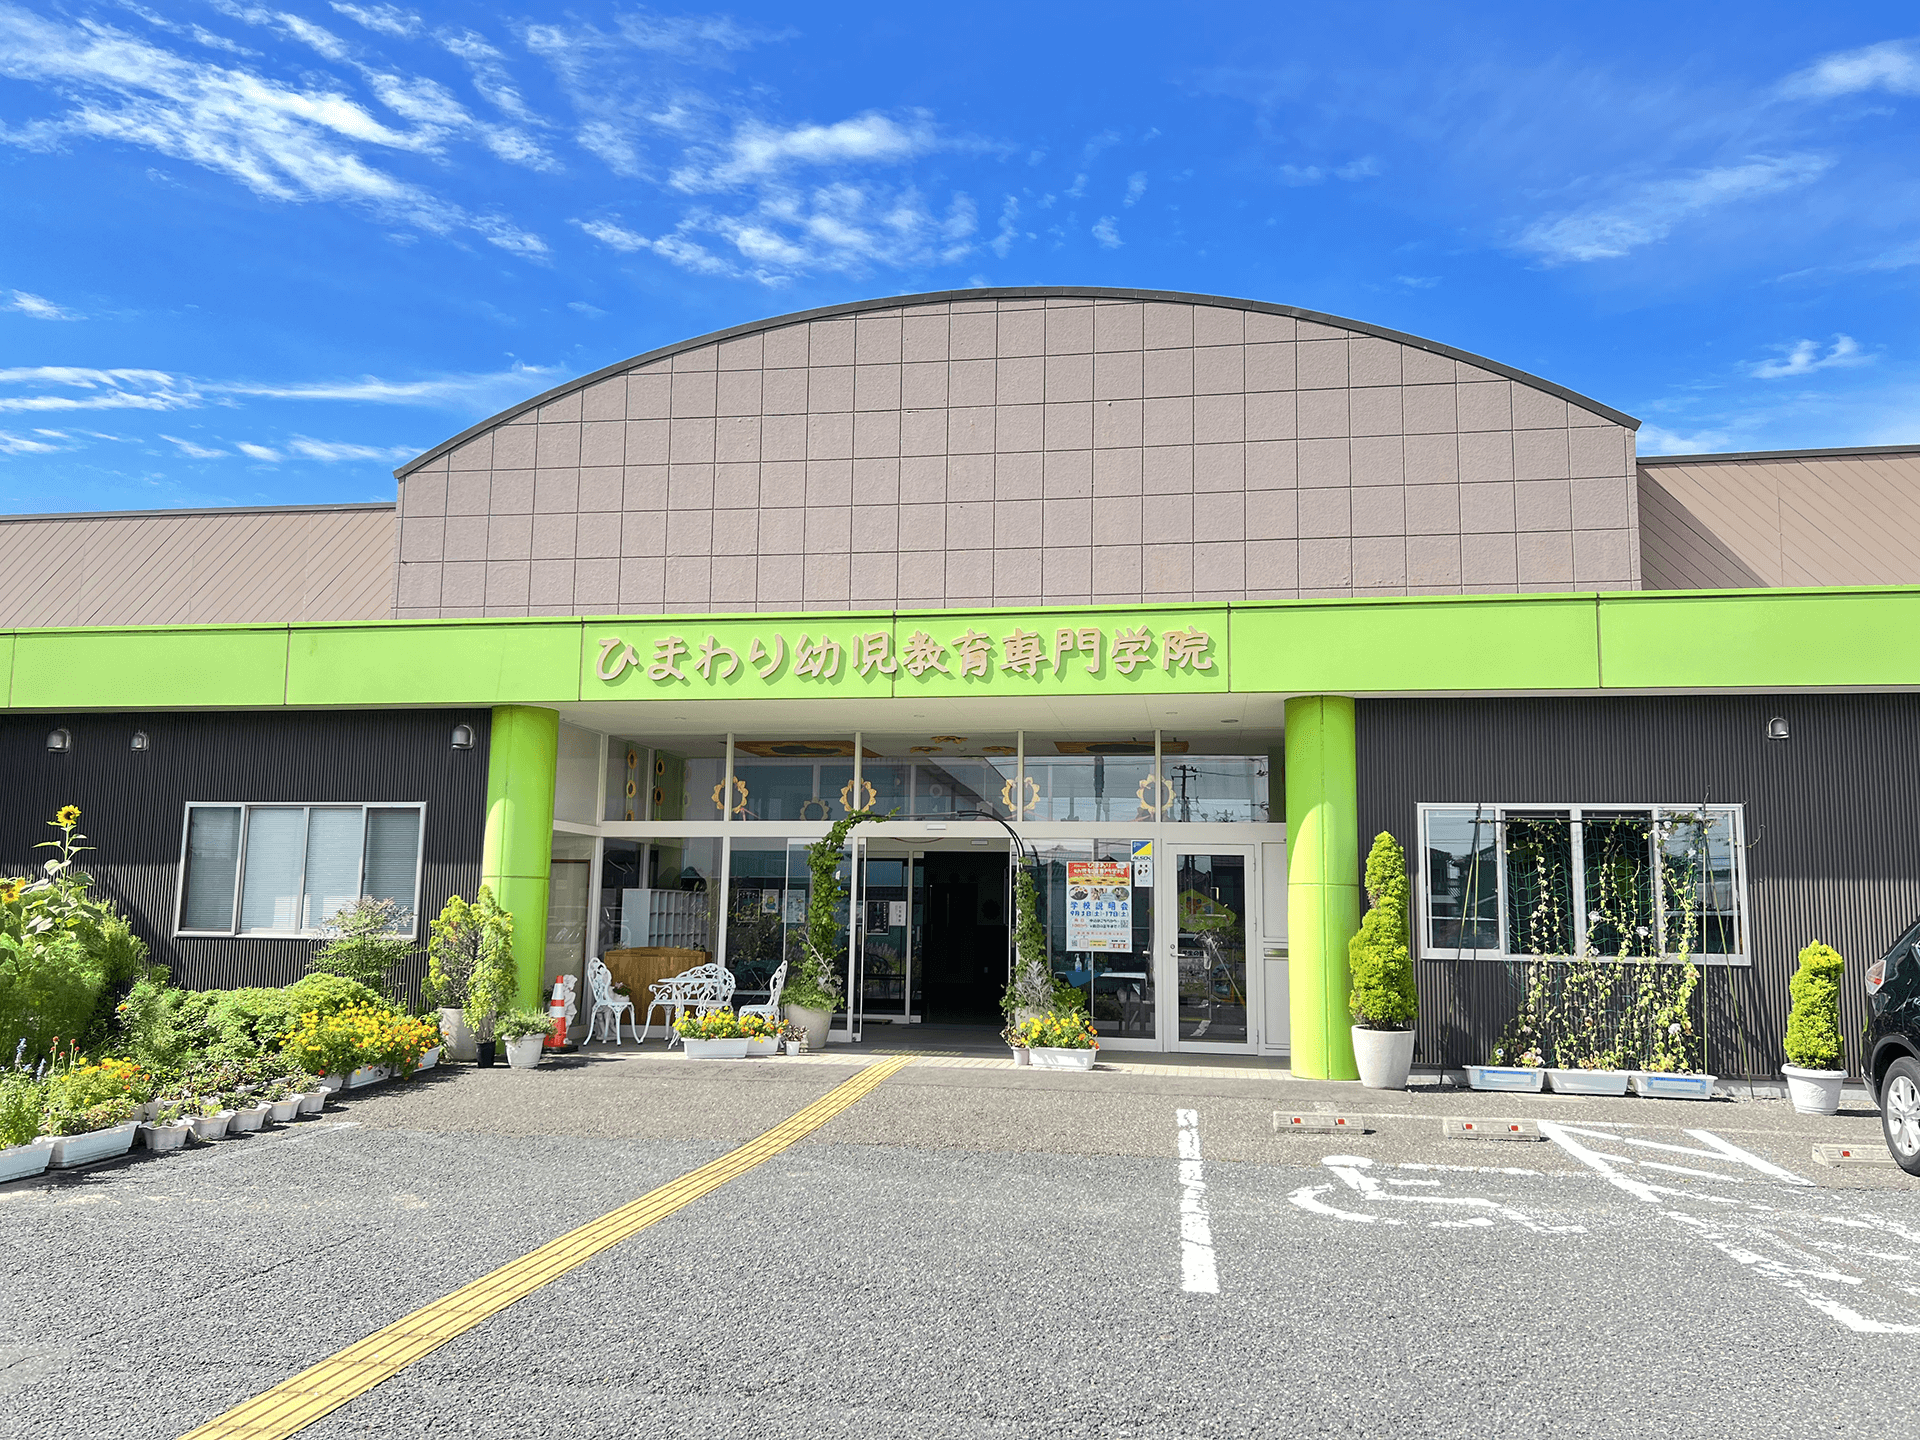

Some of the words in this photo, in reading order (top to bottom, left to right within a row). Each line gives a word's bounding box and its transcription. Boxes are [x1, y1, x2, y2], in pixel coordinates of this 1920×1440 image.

[596, 627, 1215, 682] ひまわり幼児教育専門学院
[1070, 901, 1128, 910] 学校説明会
